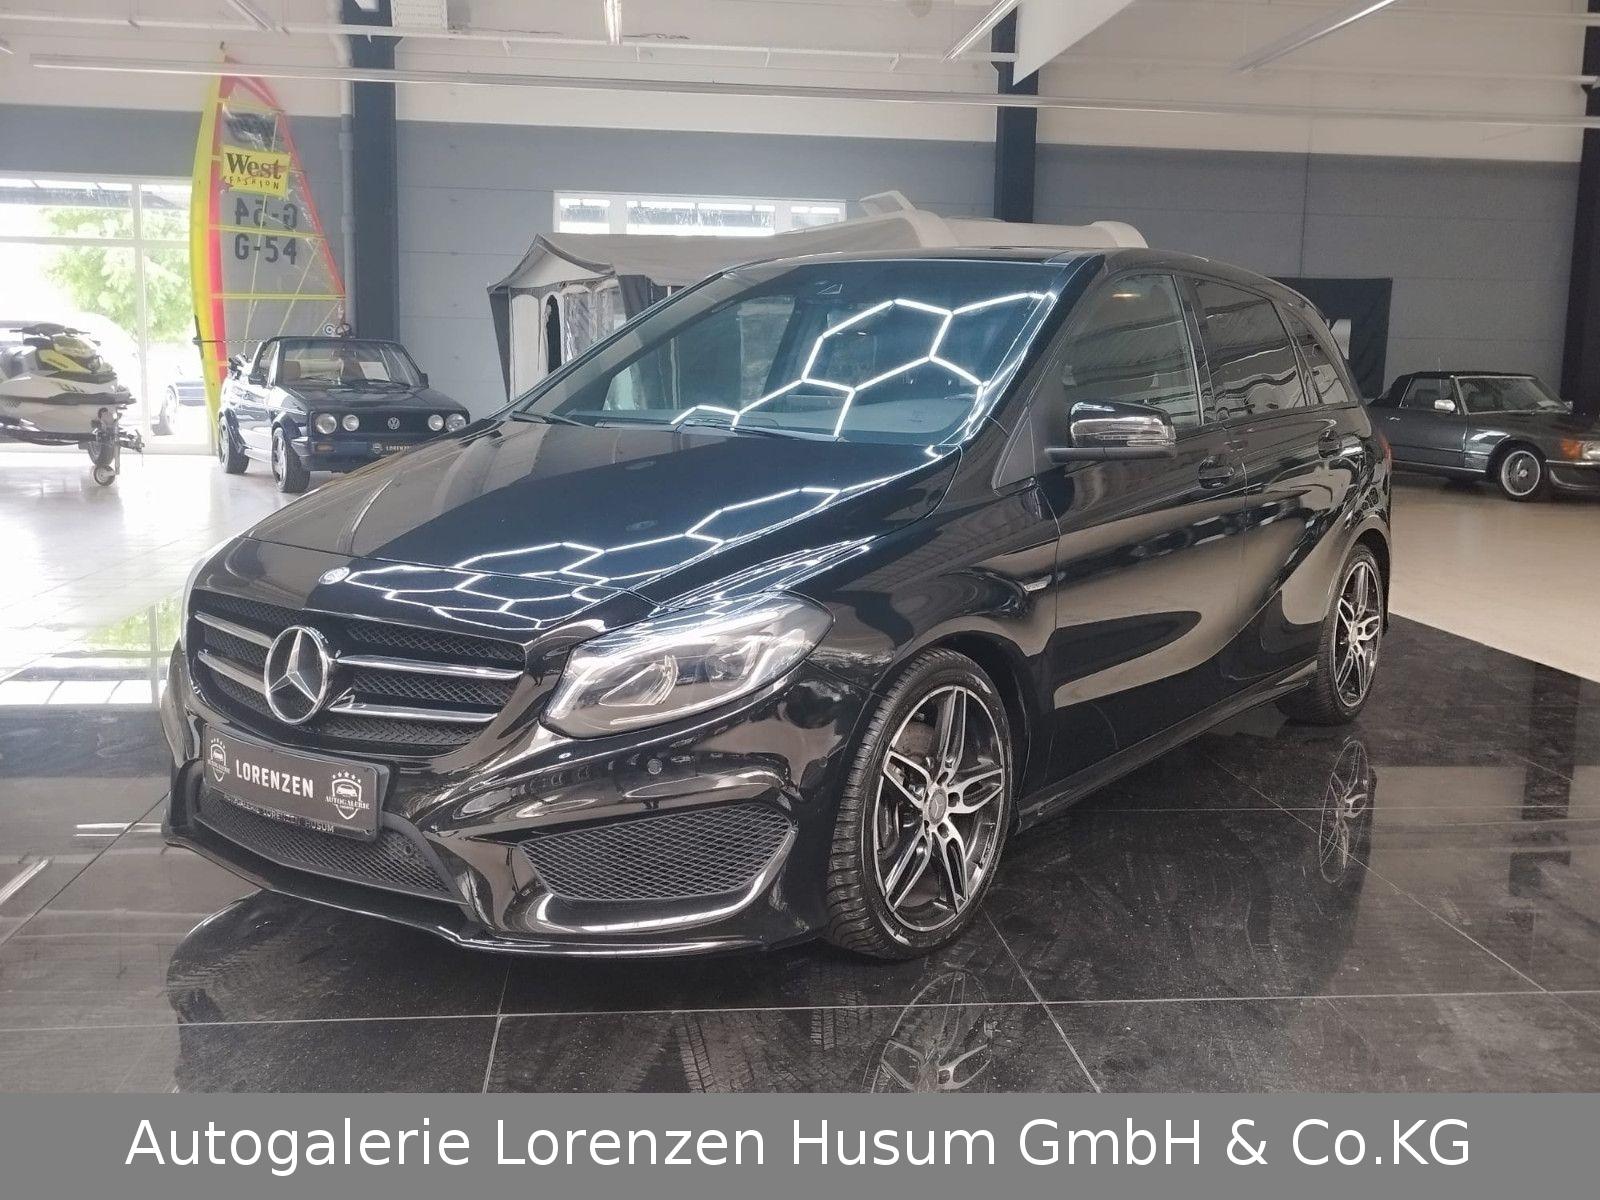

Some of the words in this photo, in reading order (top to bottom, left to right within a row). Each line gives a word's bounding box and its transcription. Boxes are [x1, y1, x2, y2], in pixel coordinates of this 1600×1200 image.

[226, 152, 281, 179] West
[234, 233, 297, 265] G-54
[236, 759, 314, 798] LORENZEN
